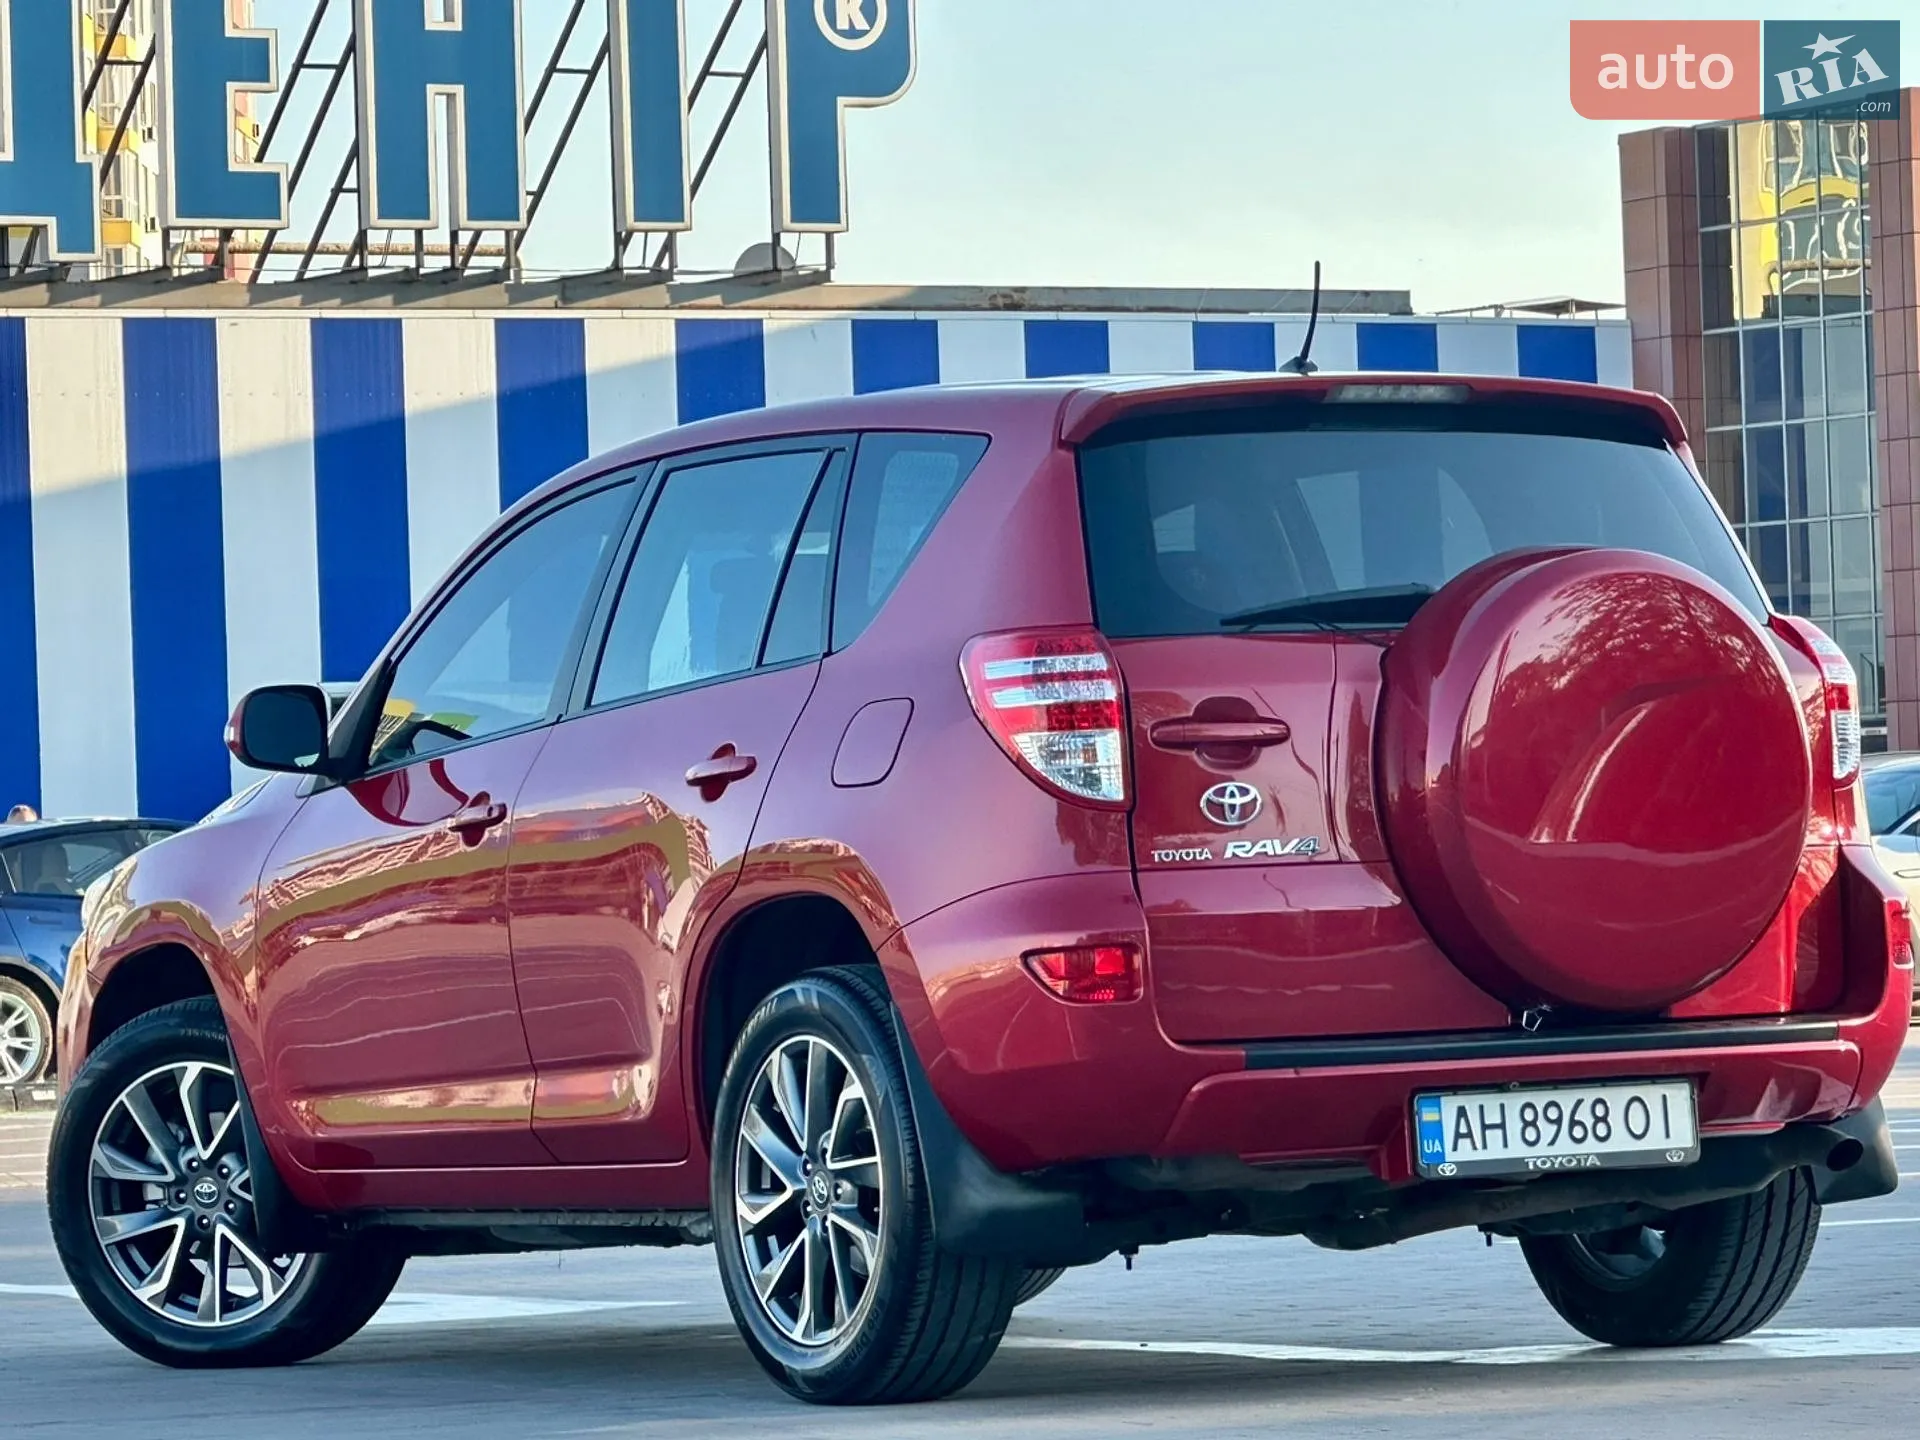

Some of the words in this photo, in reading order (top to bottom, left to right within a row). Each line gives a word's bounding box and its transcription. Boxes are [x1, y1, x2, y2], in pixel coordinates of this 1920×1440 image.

[1151, 848, 1212, 863] TOYOTA
[1224, 836, 1320, 860] RAV4
[1451, 1102, 1509, 1152] AH
[1518, 1097, 1612, 1147] 8968
[1624, 1093, 1671, 1140] OI
[1422, 1142, 1443, 1154] UA
[1524, 1154, 1601, 1171] TOYOTA
